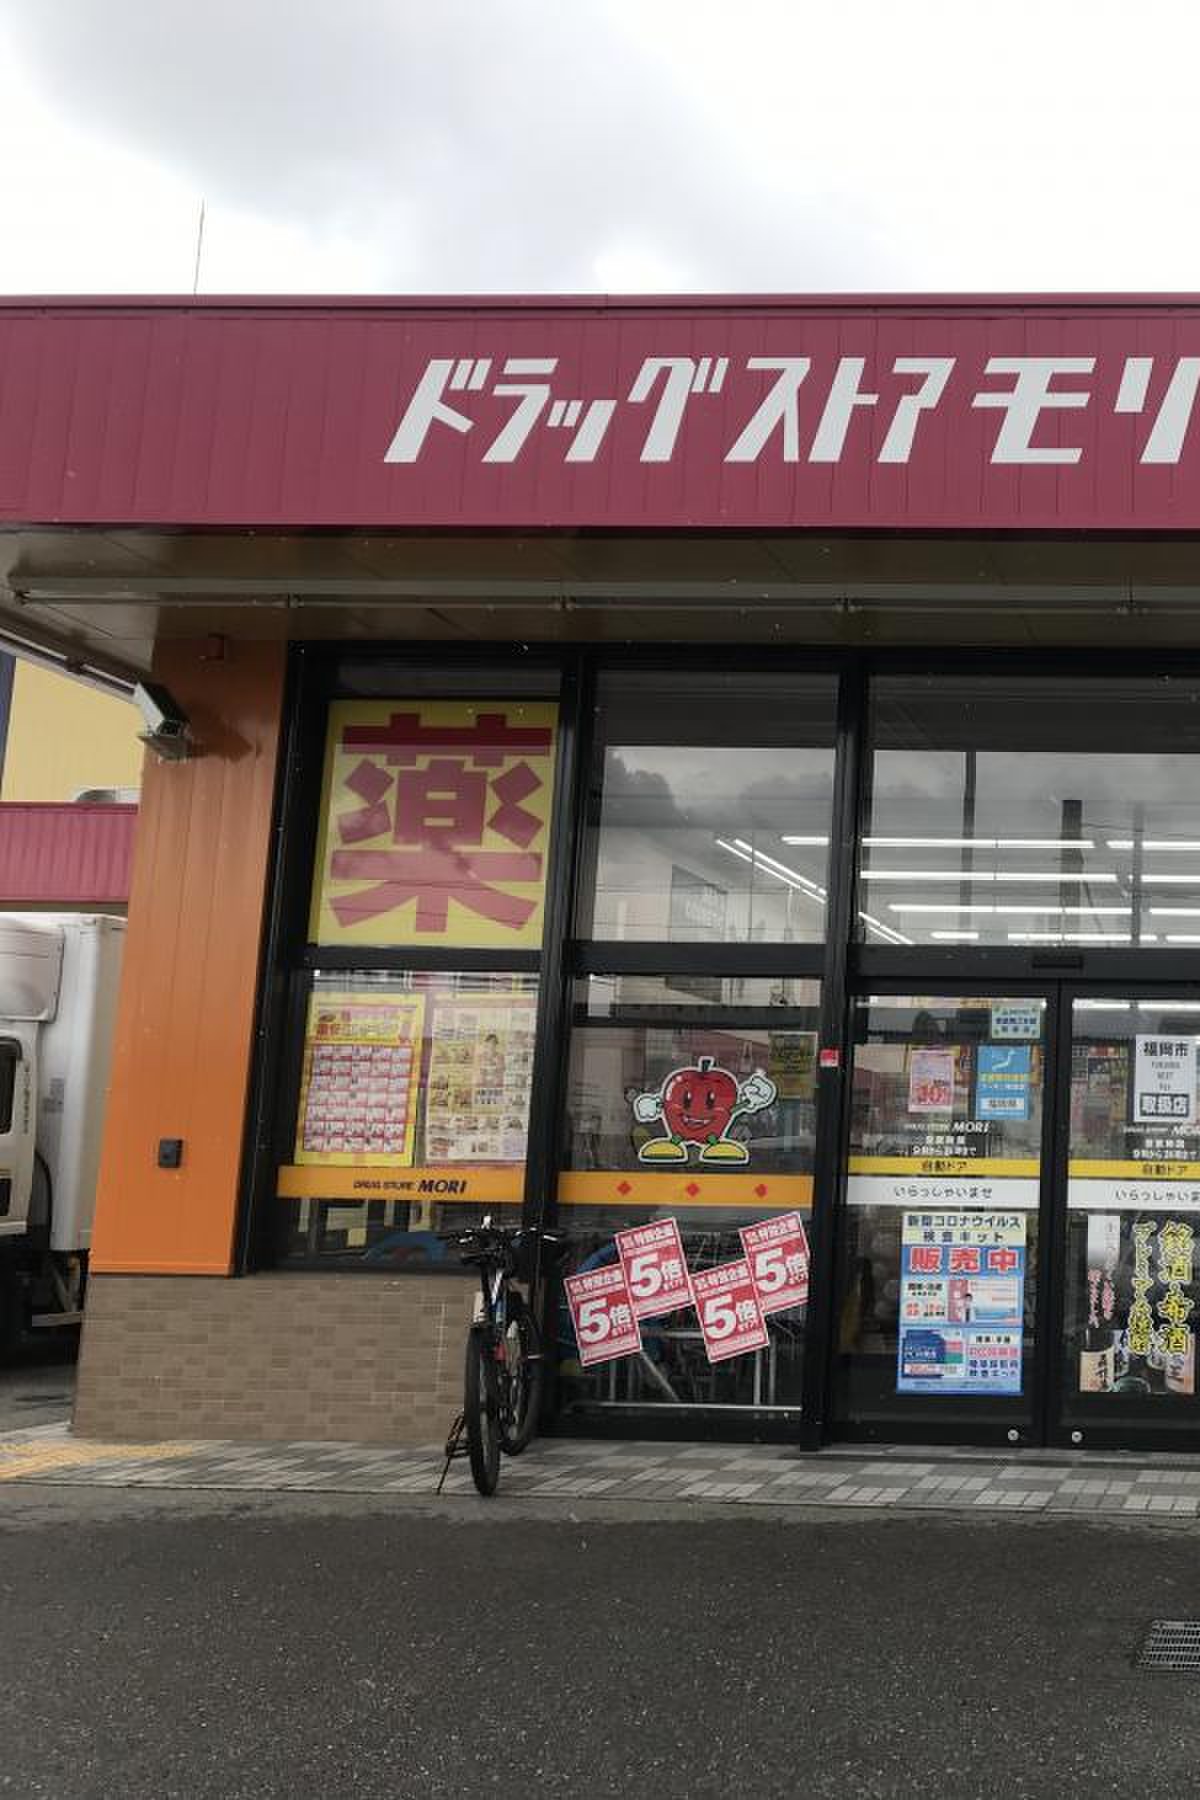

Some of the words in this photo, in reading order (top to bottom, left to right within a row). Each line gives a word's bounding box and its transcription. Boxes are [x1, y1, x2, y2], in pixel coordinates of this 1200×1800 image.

[329, 712, 553, 933] 薬
[952, 1121, 991, 1133] MORI
[417, 1178, 468, 1194] MORI
[893, 1185, 993, 1198] いらっしゃいませ
[910, 1246, 1019, 1274] 販売中
